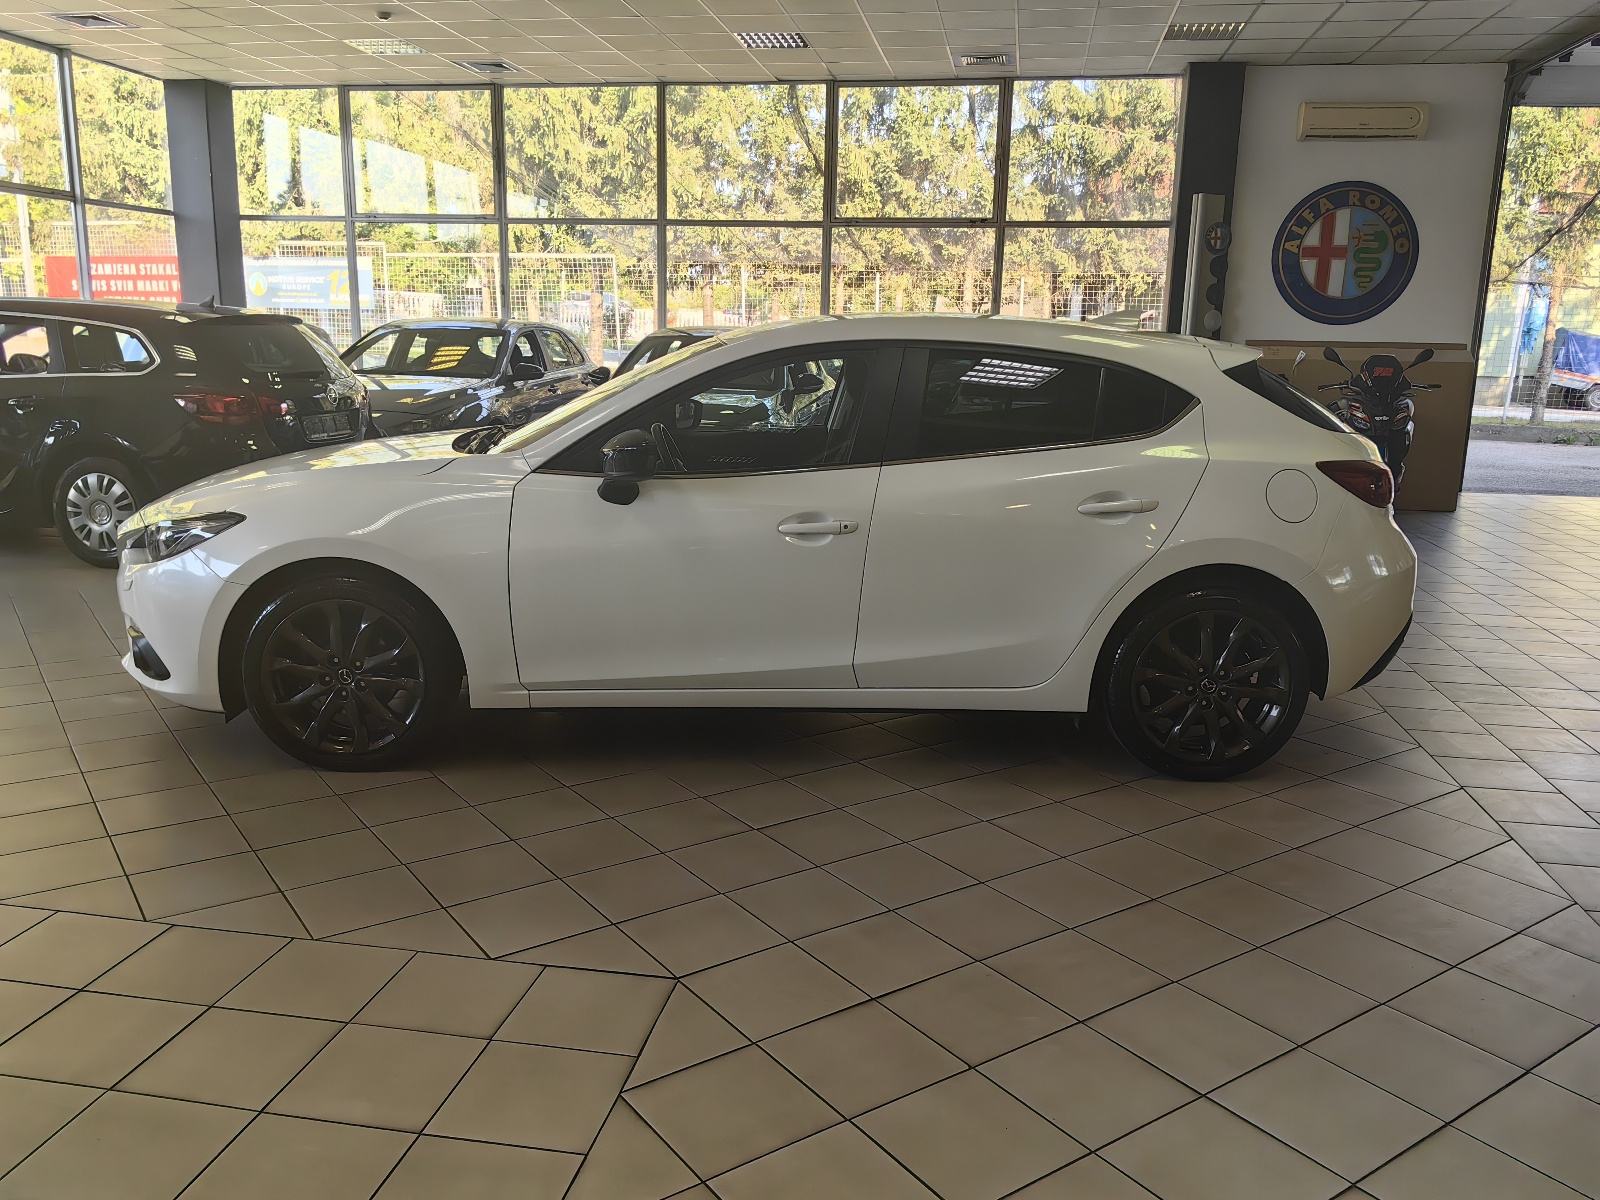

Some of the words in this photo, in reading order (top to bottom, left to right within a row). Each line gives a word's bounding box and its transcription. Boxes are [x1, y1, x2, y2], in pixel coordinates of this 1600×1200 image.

[1284, 197, 1334, 254] ALFA
[1348, 190, 1410, 255] ROMEO
[90, 263, 137, 275] ZAMJENA
[137, 279, 169, 292] MARKI
